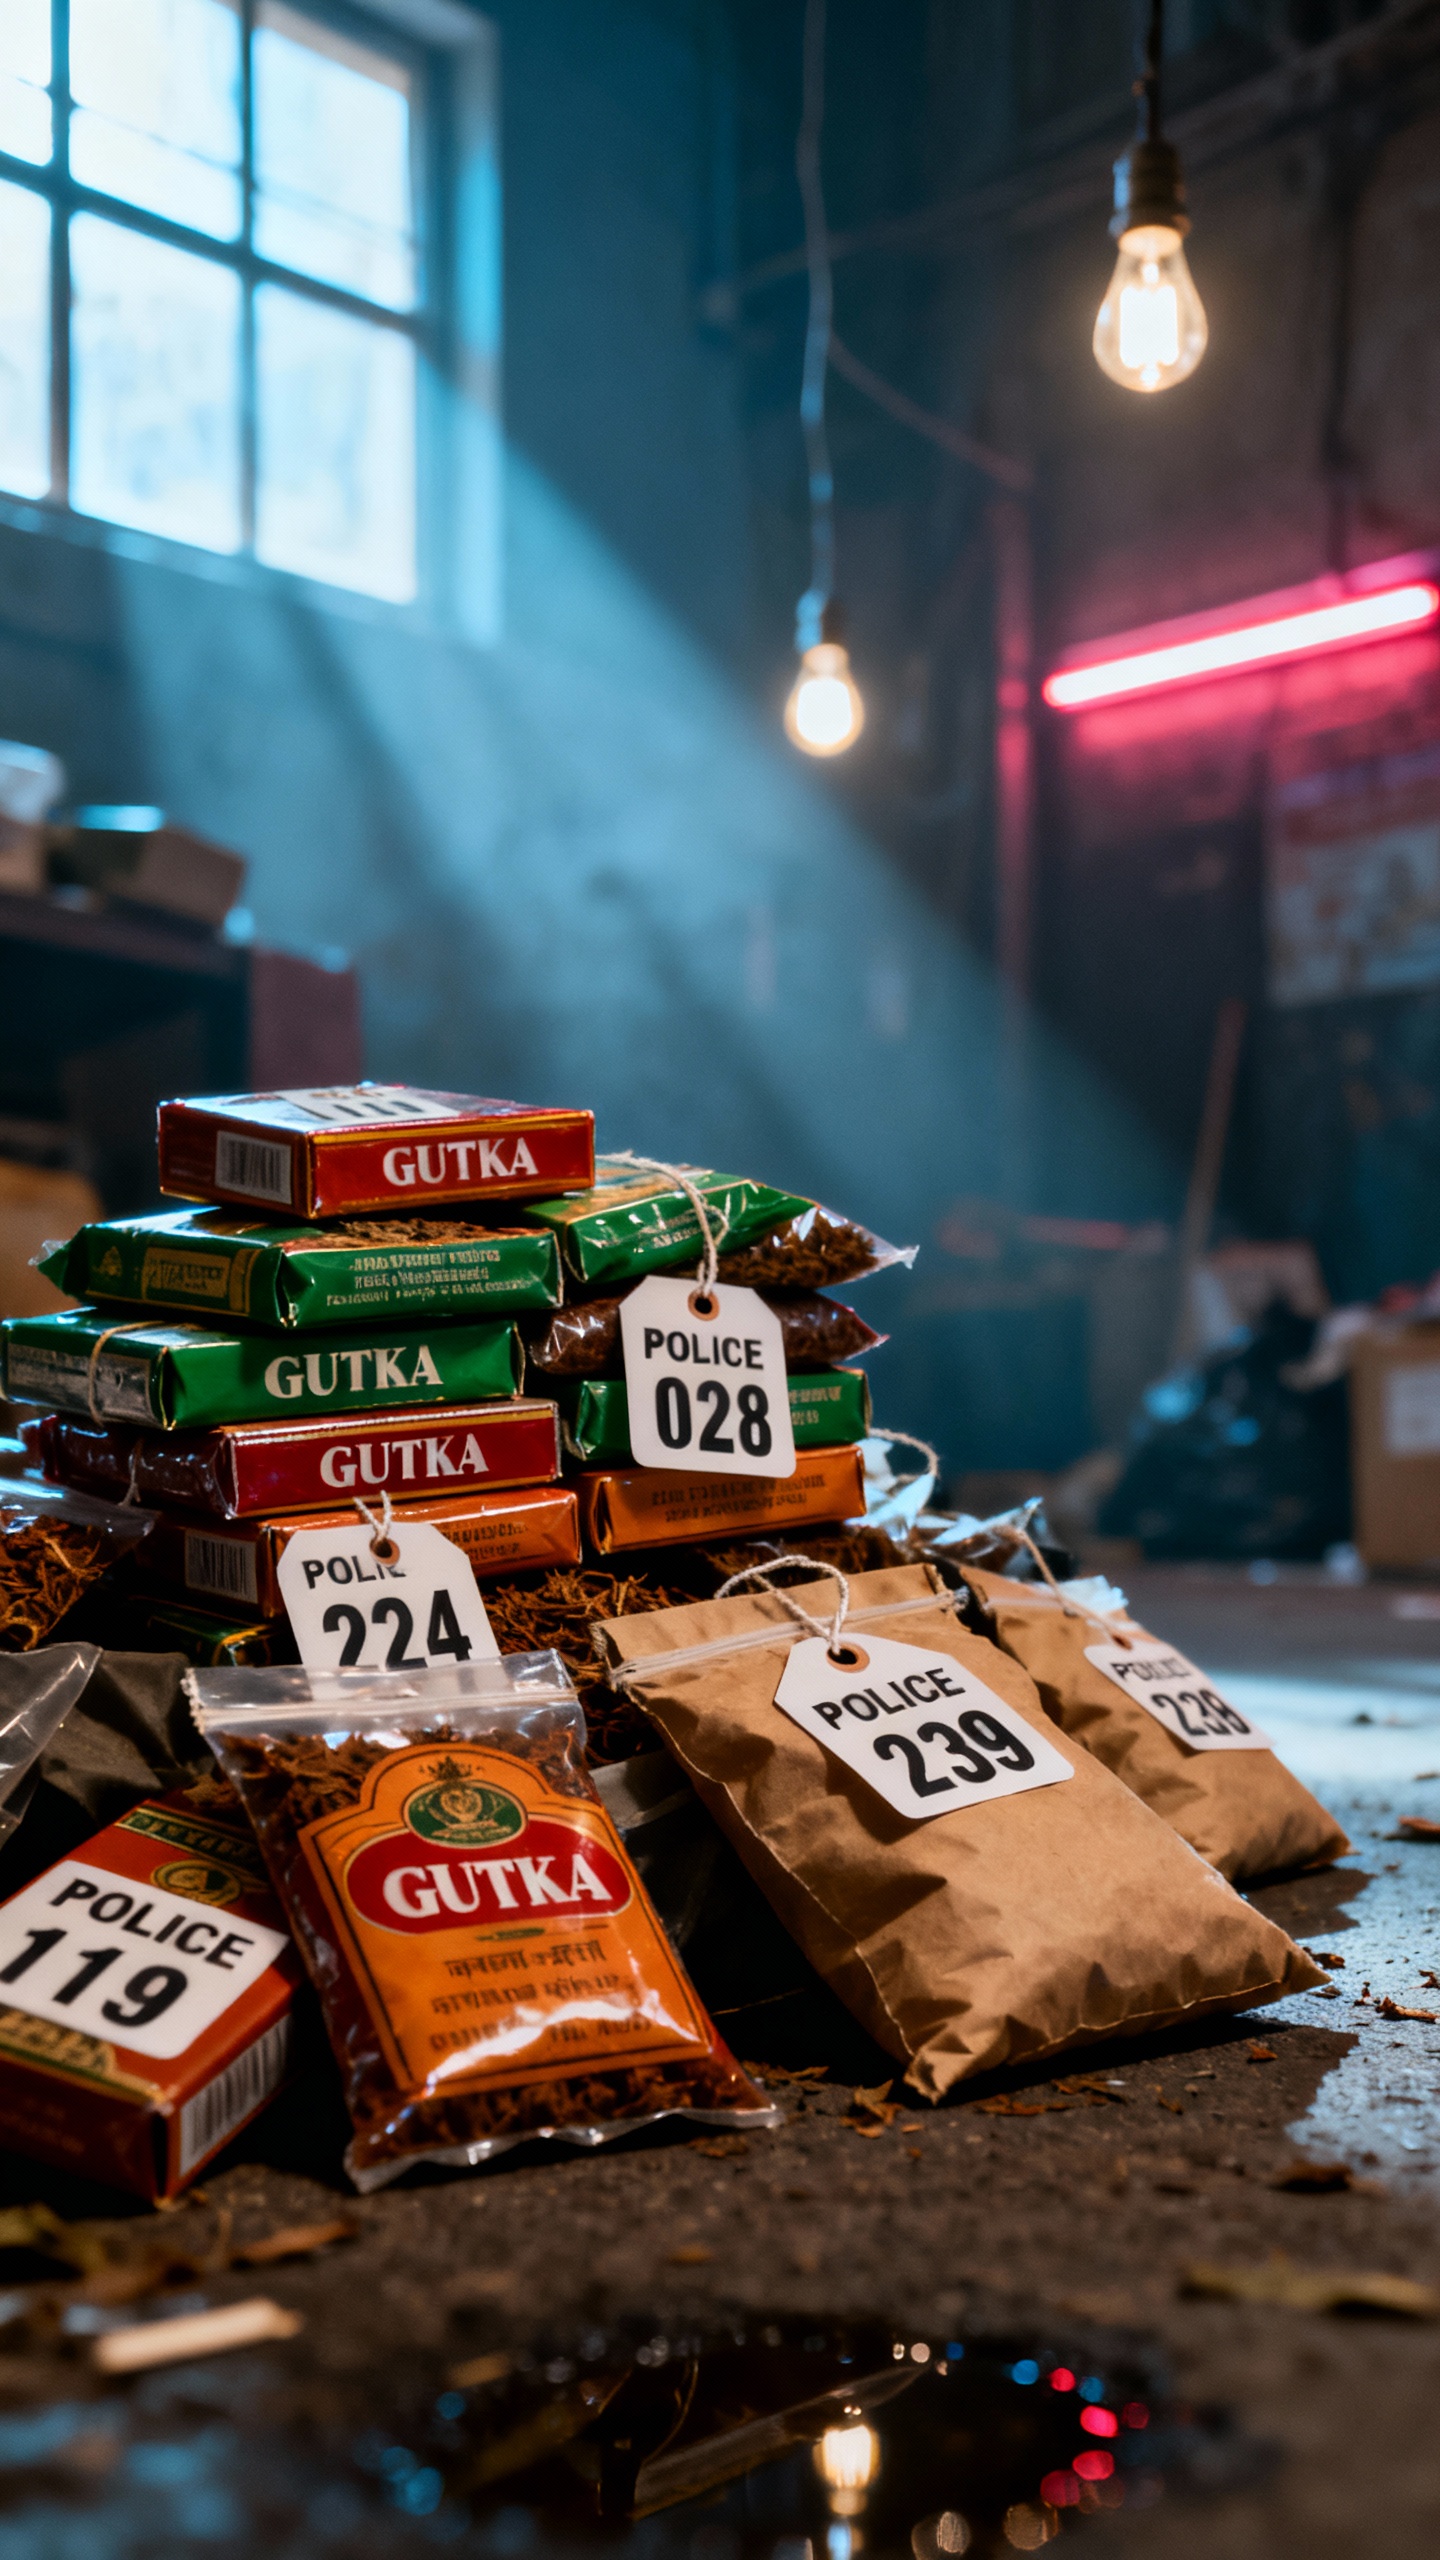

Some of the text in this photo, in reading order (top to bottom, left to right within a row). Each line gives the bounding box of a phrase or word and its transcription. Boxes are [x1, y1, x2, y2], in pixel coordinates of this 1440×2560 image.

[382, 1136, 540, 1187] GUTKA
[264, 1344, 445, 1399] GUTKA
[643, 1326, 764, 1370] POLICE
[655, 1376, 772, 1458] 028
[319, 1432, 490, 1488] GUTKA
[322, 1588, 473, 1669] 224
[811, 1667, 966, 1730] POLICE
[872, 1709, 1035, 1798] 239
[382, 1852, 614, 1919] GUTKA
[49, 1878, 255, 1970] POLICE
[0, 1927, 188, 2028] 119
